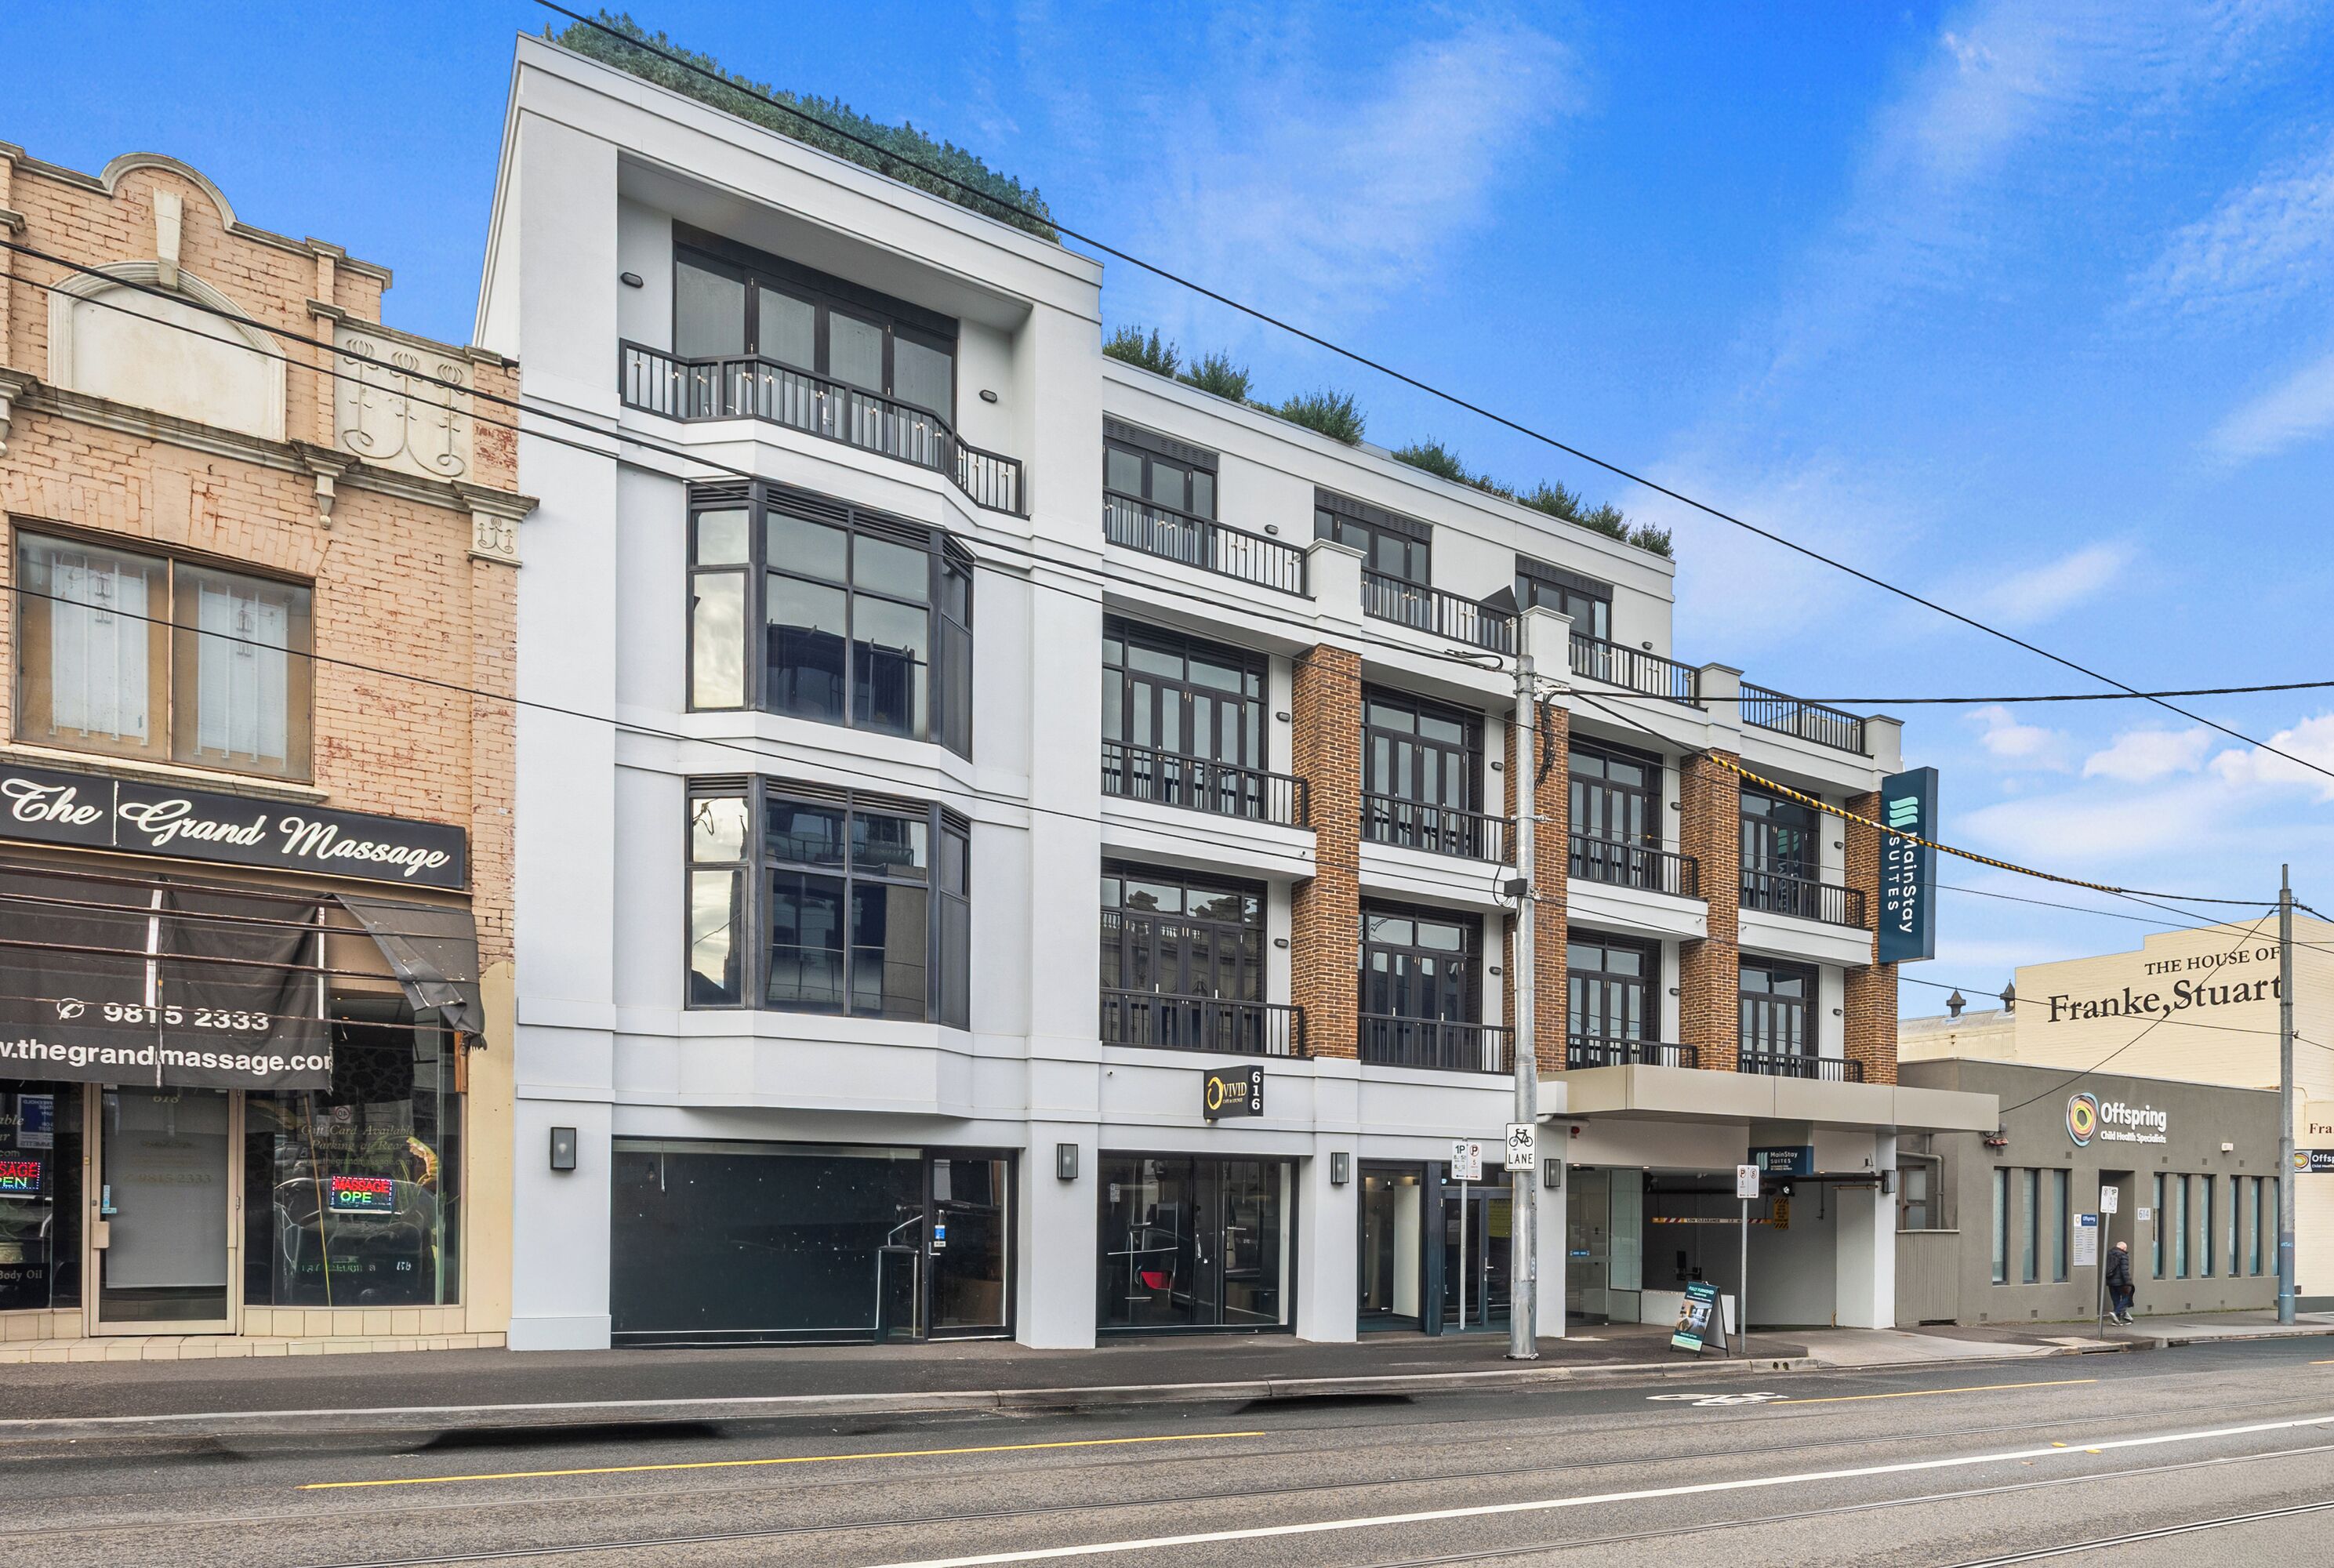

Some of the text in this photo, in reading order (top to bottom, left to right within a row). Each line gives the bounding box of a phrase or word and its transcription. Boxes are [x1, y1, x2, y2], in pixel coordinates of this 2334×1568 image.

[1, 778, 450, 877] The Grand Massage
[1888, 837, 1900, 911] SUITES
[2144, 946, 2281, 975] THE HOUSE OF
[103, 1002, 270, 1030] 9815 2333
[1223, 1082, 1247, 1097] VIVID
[1251, 1071, 1261, 1110] 616
[2100, 1102, 2166, 1132] Offspring
[329, 1125, 358, 1135] Card
[362, 1125, 416, 1135] Available
[2100, 1131, 2167, 1144] Child Health Specialists
[1455, 1145, 1465, 1154] 1P
[1508, 1153, 1533, 1164] LANE
[335, 1178, 390, 1193] MASSAGE
[2139, 1209, 2149, 1218] 614
[27, 1269, 42, 1279] Oil
